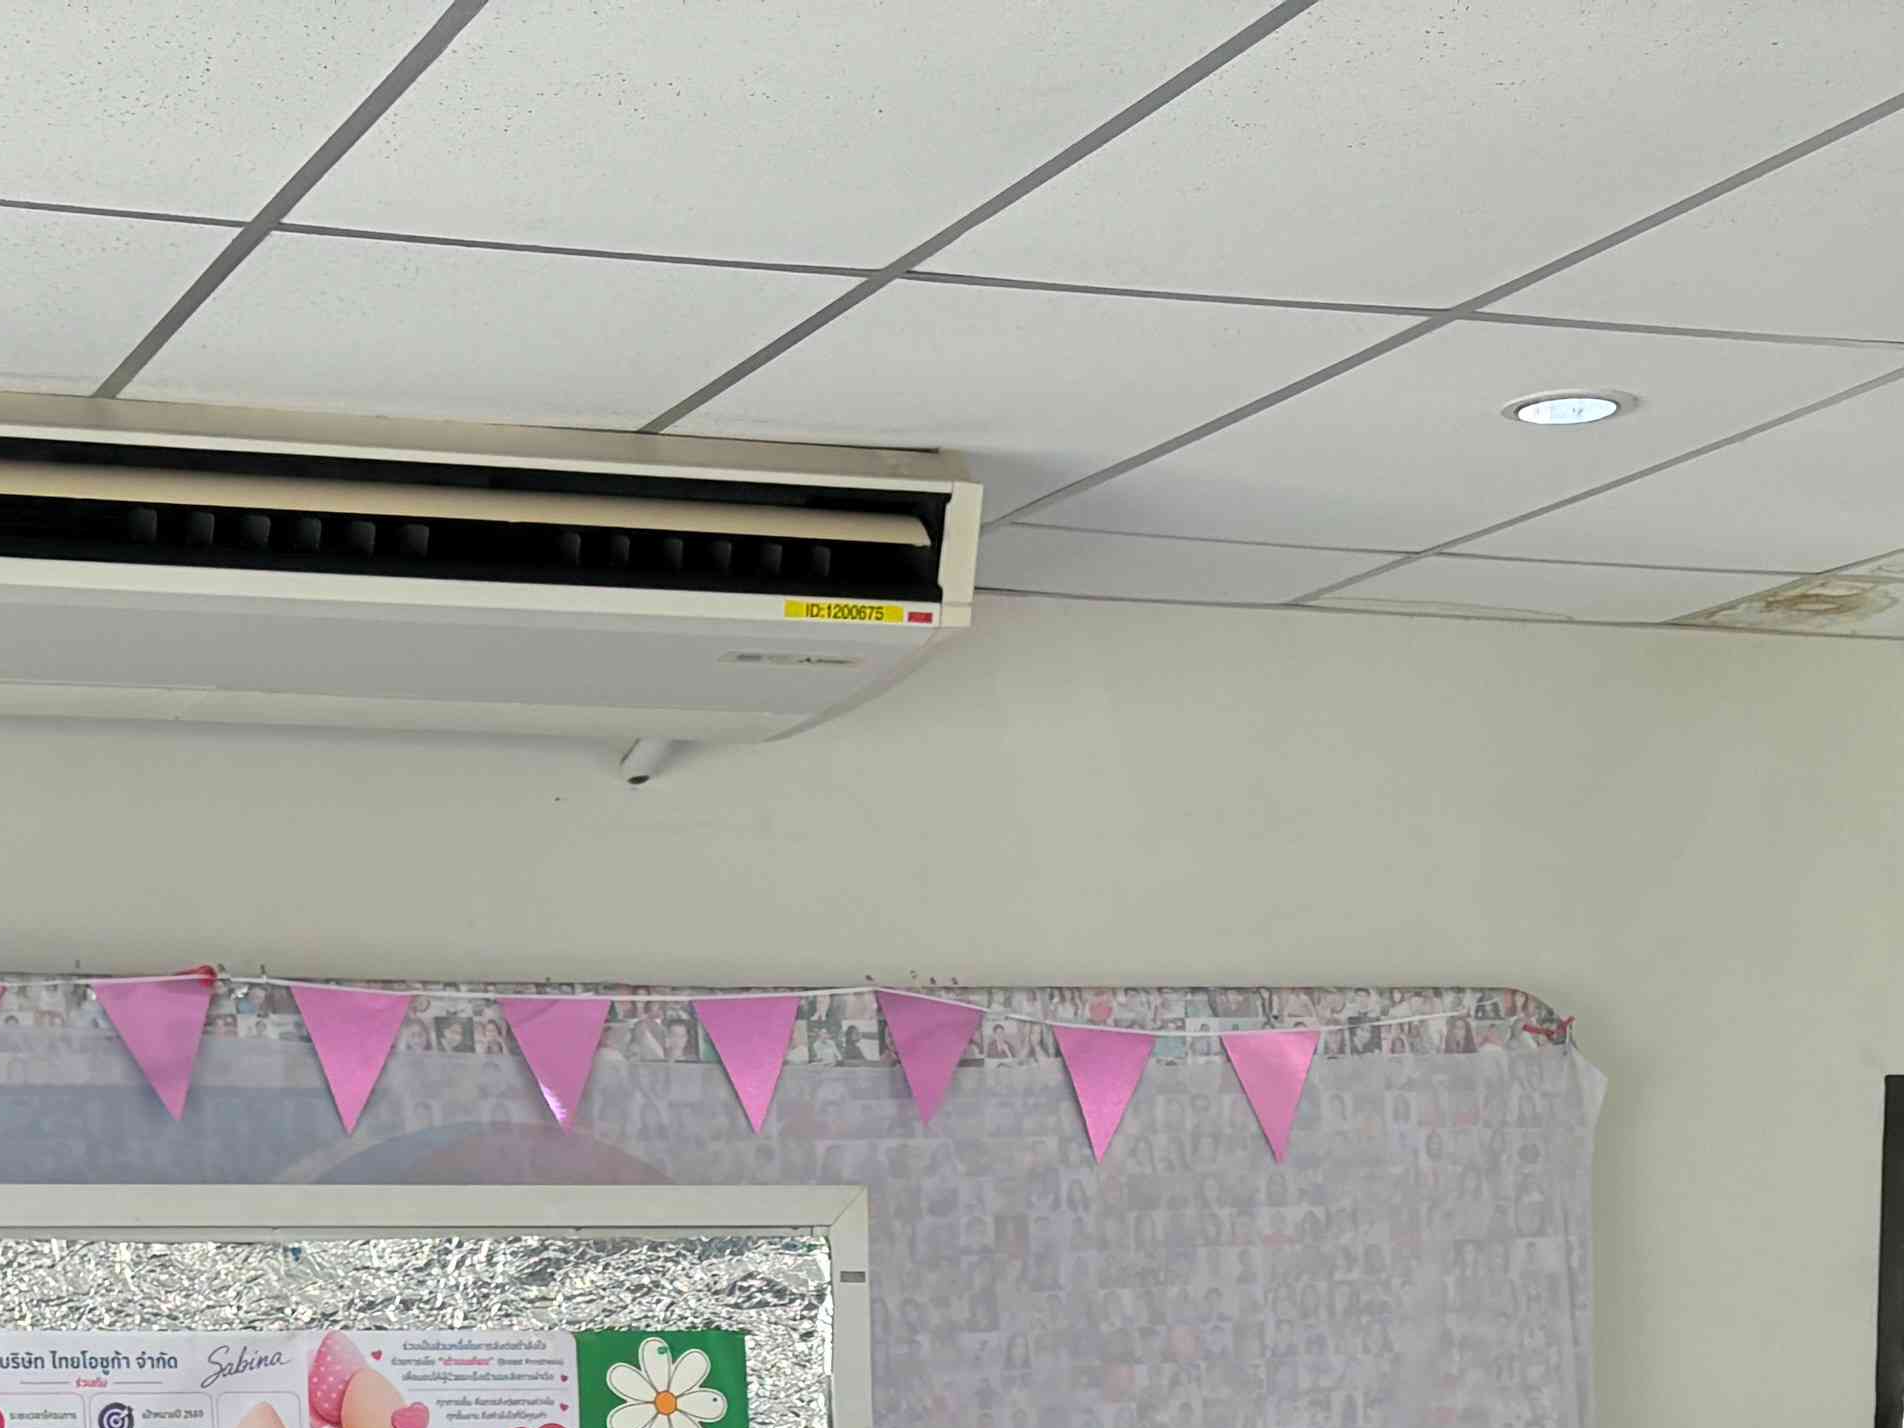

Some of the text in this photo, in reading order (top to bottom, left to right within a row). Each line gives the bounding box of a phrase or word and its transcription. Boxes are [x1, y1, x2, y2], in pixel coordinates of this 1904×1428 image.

[805, 603, 884, 621] ID:1200675
[49, 1350, 131, 1376] ไทยโอซูก้า
[135, 1351, 178, 1370] จำกัด
[200, 1345, 291, 1389] Sabina
